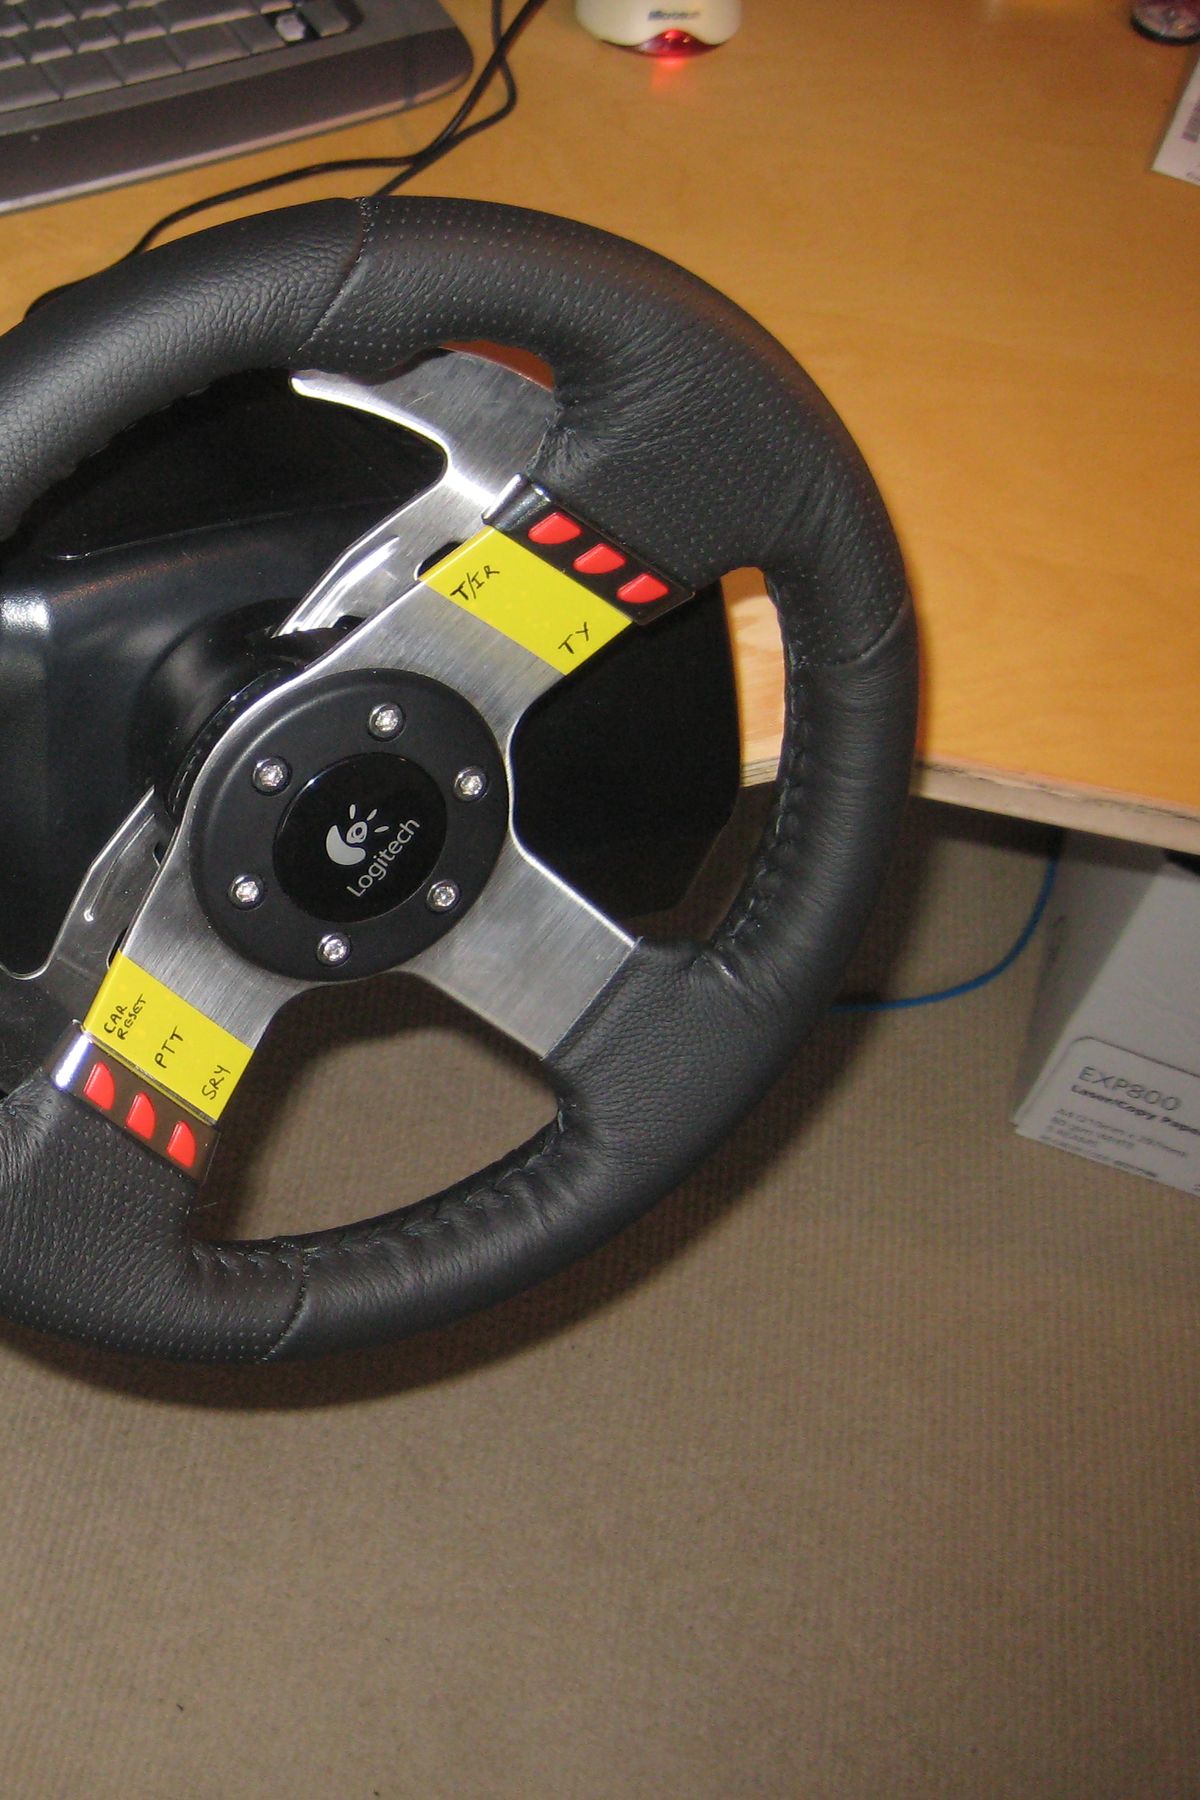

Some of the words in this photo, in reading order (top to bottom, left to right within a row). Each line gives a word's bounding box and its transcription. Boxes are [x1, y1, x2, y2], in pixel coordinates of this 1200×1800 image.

[450, 564, 501, 601] T/IR
[345, 818, 421, 898] Logitech
[103, 1003, 128, 1034] CAR
[116, 993, 147, 1040] RESET
[153, 1025, 185, 1069] PTT
[201, 1064, 232, 1101] SRY
[1078, 1065, 1182, 1111] EXP800
